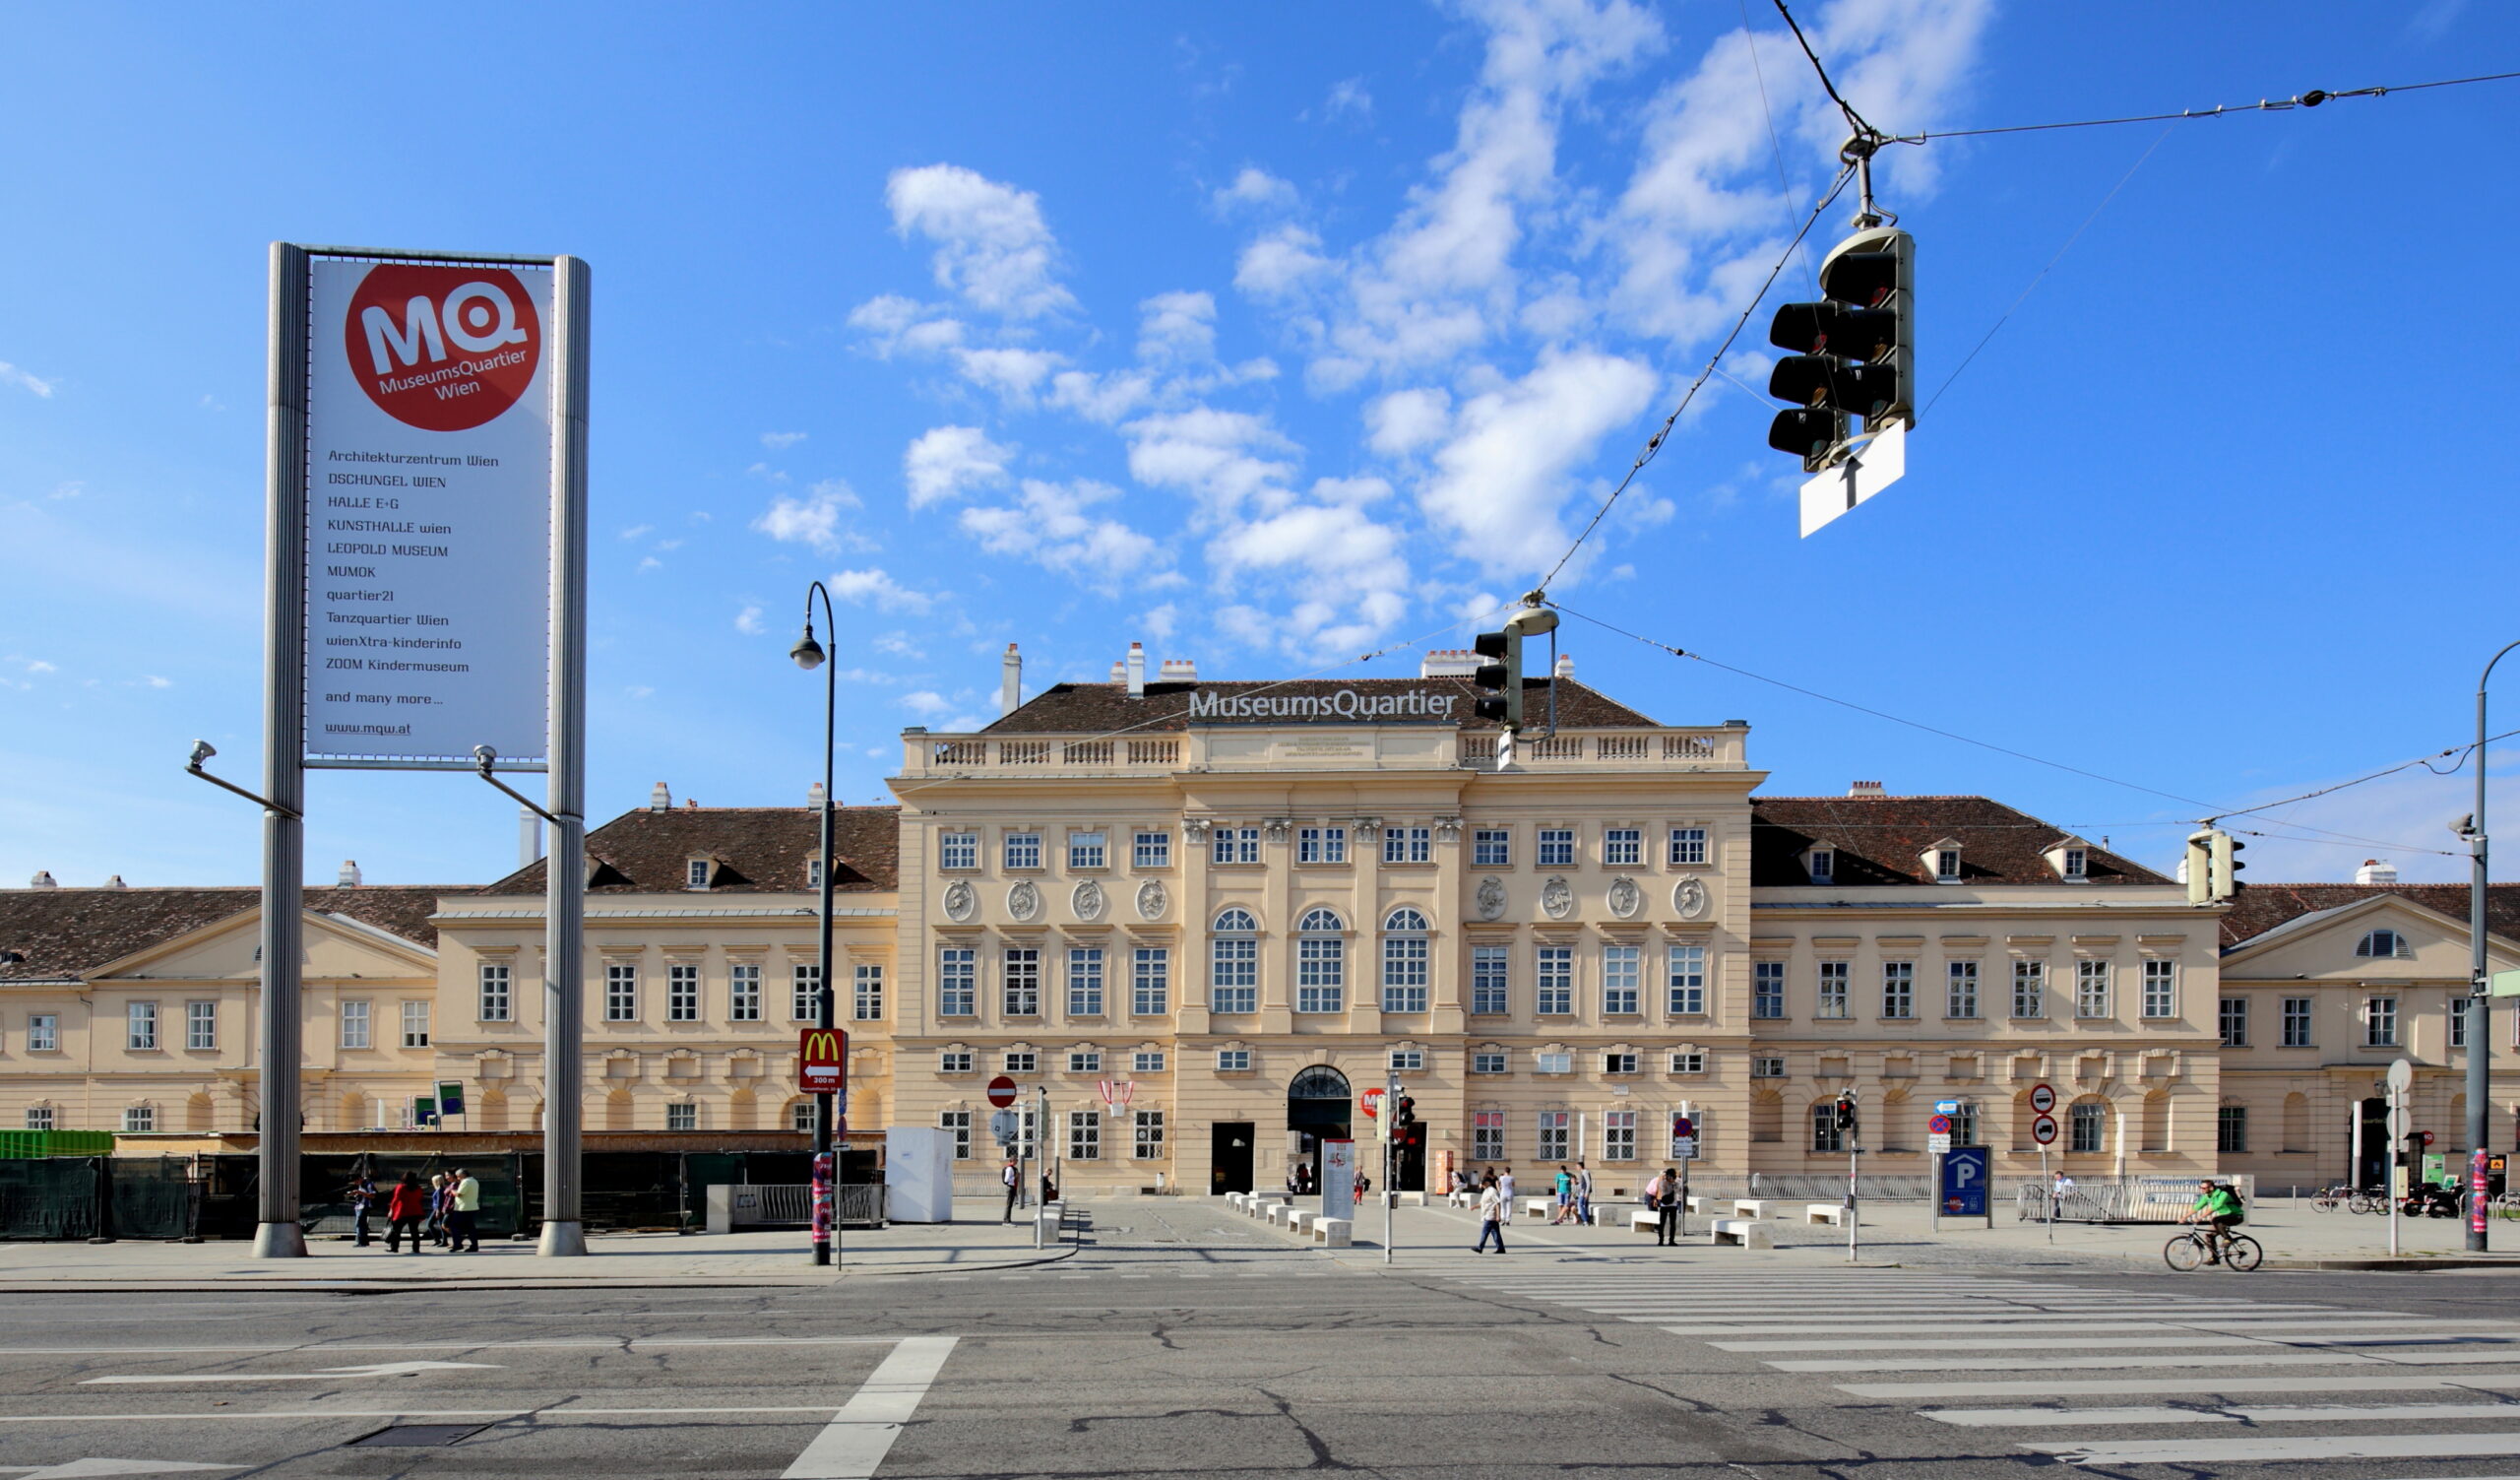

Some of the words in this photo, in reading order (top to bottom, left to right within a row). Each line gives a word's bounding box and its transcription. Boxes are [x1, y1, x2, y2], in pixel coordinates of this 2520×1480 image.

[361, 281, 528, 375] MQ
[379, 350, 527, 394] MuseumsQuartier
[434, 380, 480, 401] Wien
[328, 450, 462, 466] Architekturzentrum
[467, 455, 499, 467] Wien
[328, 473, 408, 487] DSCHUNGEL
[412, 477, 446, 487] WIEN
[328, 496, 371, 509] HALLE
[328, 519, 414, 533] KUNSTHALLE
[419, 523, 452, 534] wien
[327, 543, 387, 555] LEOPOLD
[392, 545, 449, 557] MUSEUM
[327, 565, 376, 578] MUMOK
[327, 590, 394, 602] quartier21
[326, 611, 411, 625] Tanzquartier
[416, 614, 449, 626] Wien
[326, 635, 462, 650] wienXtra-kinderinfo
[326, 658, 363, 670] ZOOM
[368, 659, 470, 673] Kindermuseum
[325, 691, 350, 702] and
[355, 694, 392, 706] many
[1188, 689, 1459, 719] MuseumsQuartier
[325, 723, 411, 736] www.mqw.at
[1956, 1163, 1976, 1189] P
